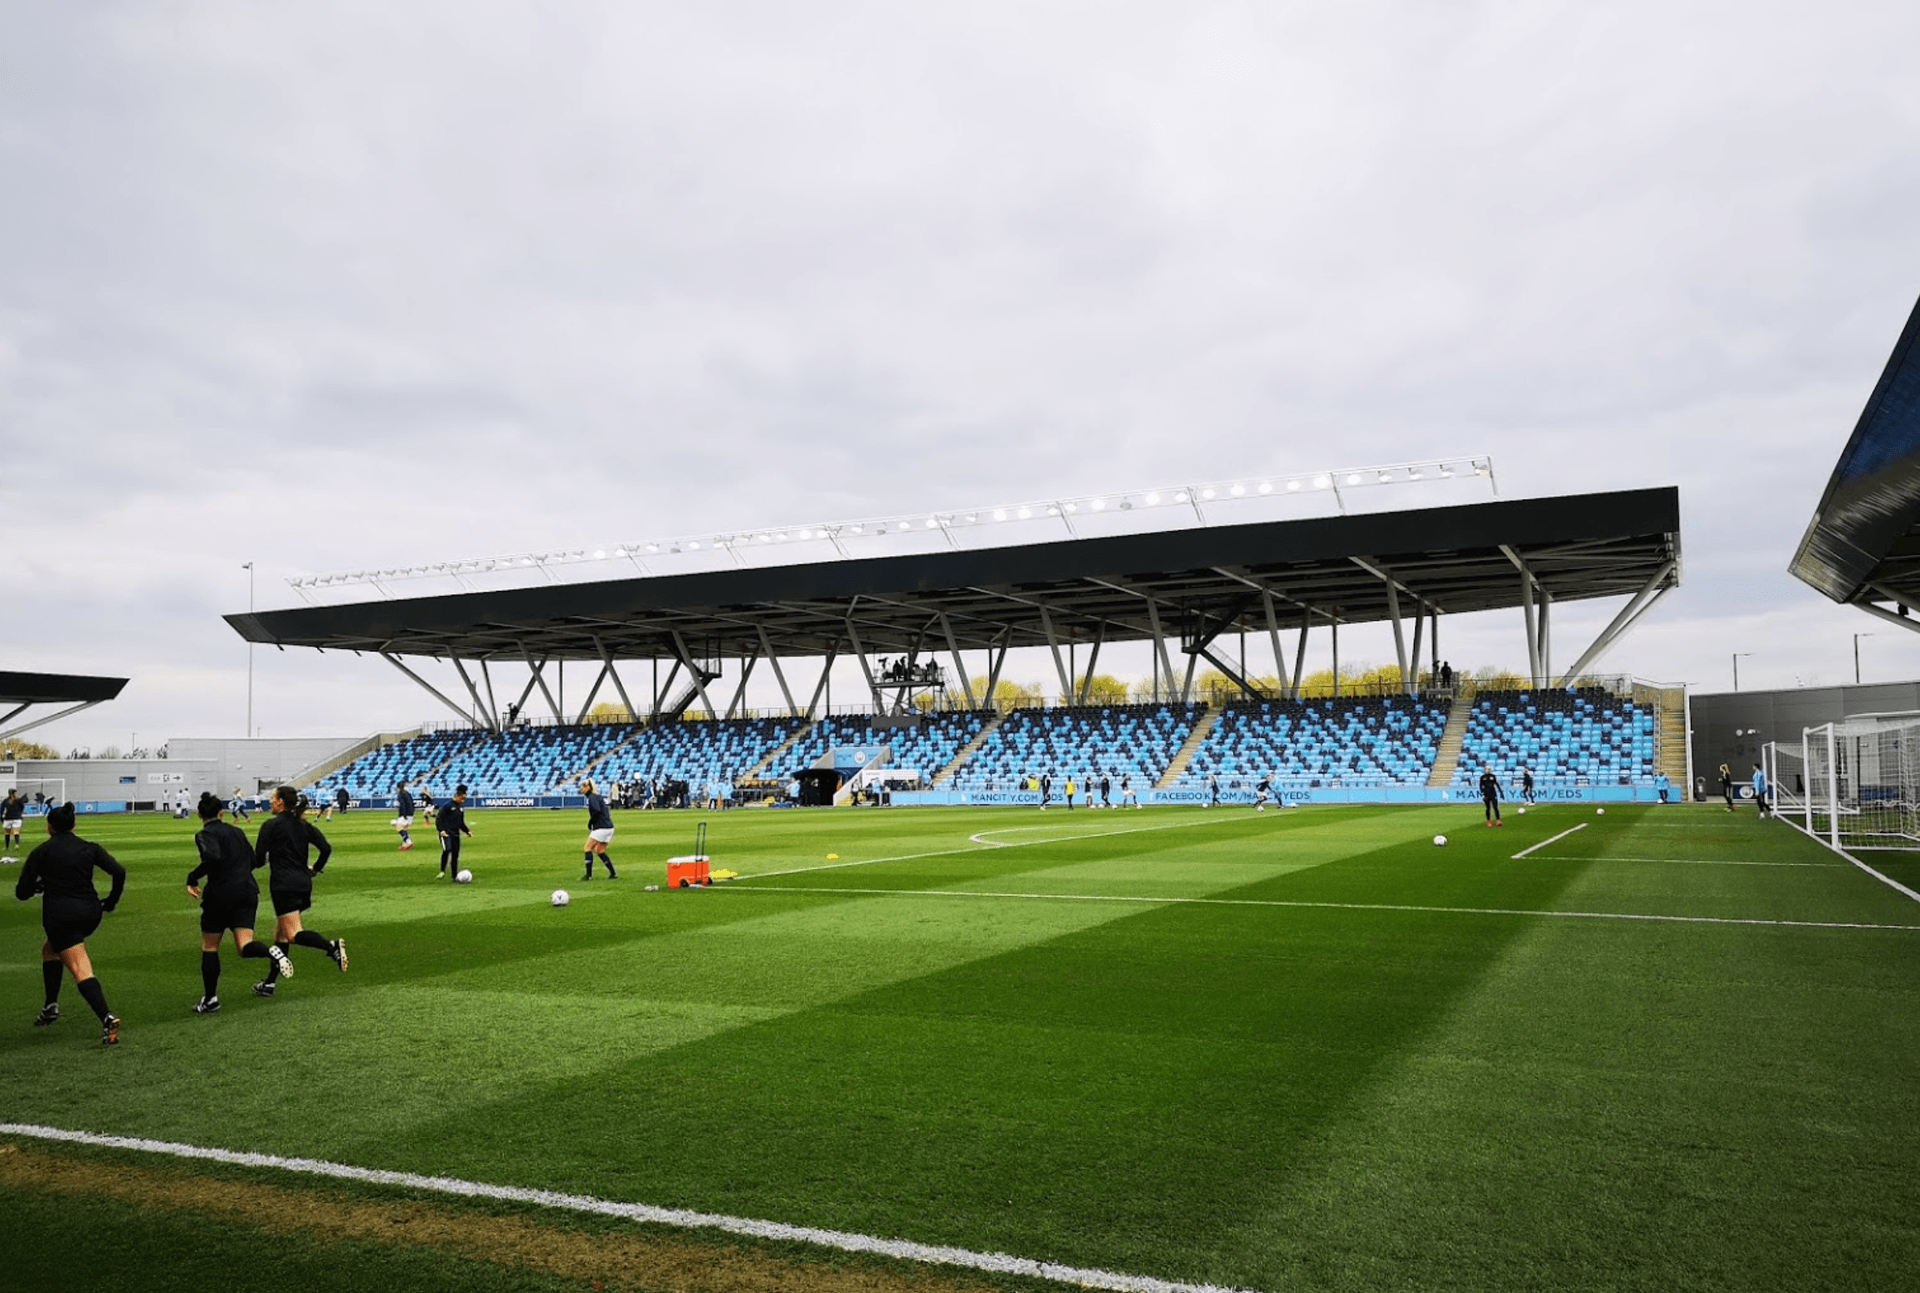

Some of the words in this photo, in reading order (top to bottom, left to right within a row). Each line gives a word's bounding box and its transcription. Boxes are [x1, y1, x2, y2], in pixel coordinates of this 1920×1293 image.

[971, 794, 1064, 802] MANCITY.COMDS
[1155, 791, 1311, 801] FACEBOOKOM/MAYEDS
[1456, 789, 1582, 799] MANY.COM/EDS
